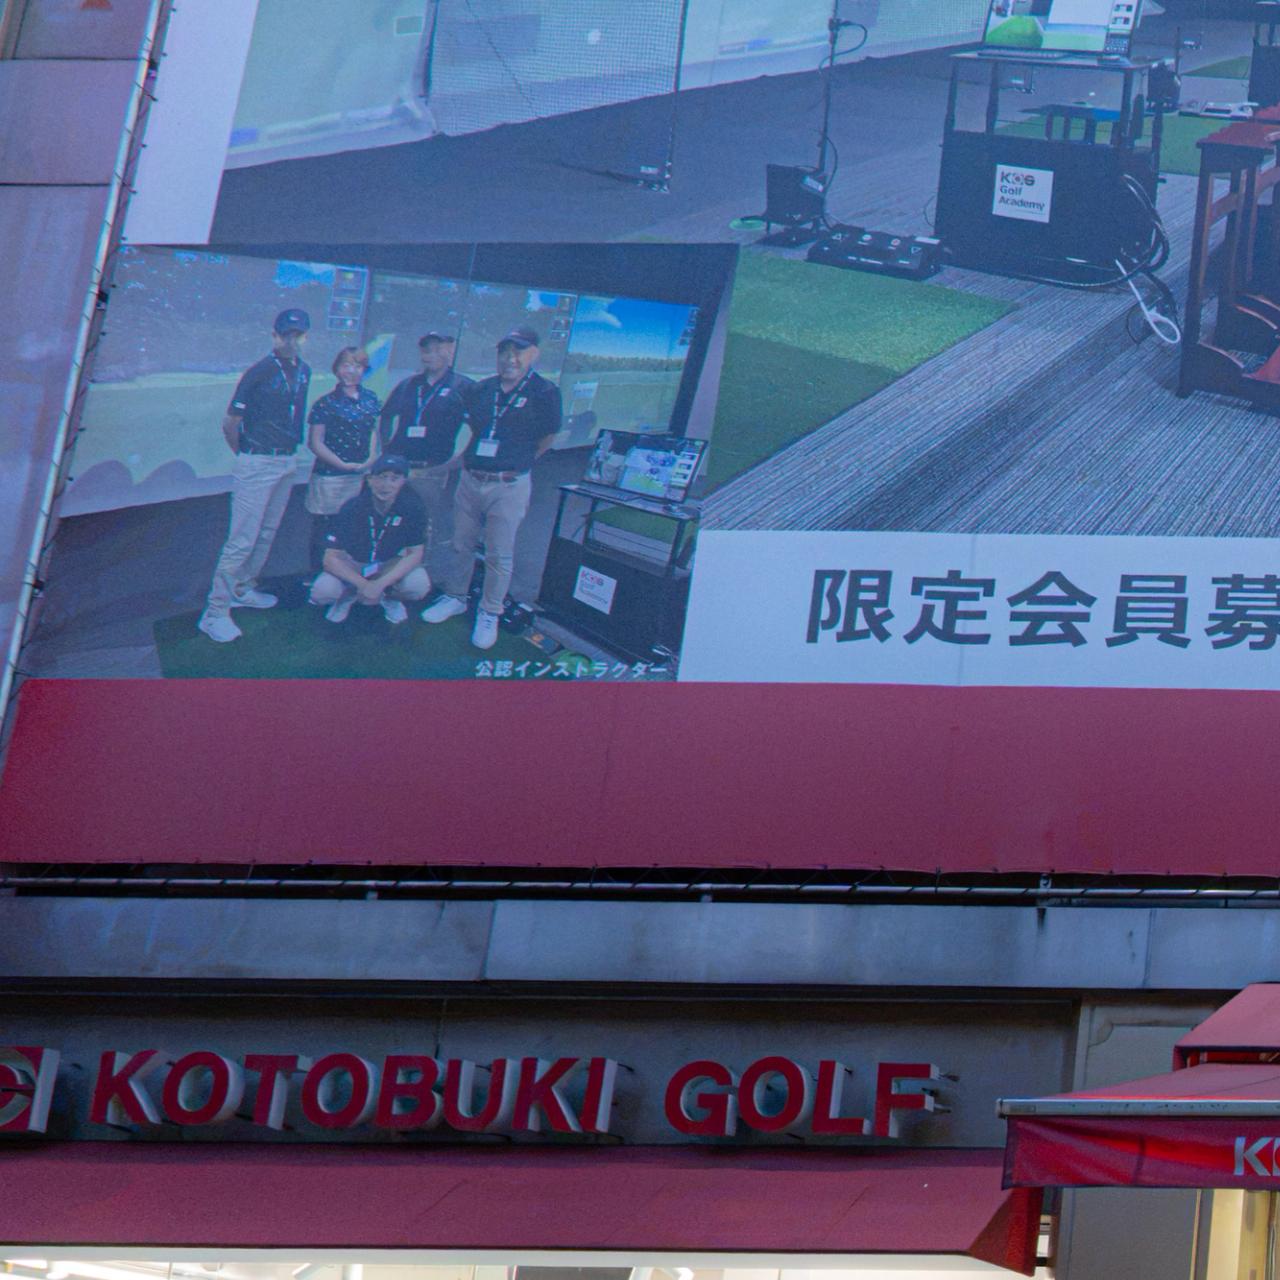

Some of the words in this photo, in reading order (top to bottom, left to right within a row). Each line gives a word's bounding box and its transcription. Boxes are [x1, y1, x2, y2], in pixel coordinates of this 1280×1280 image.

[1000, 185, 1023, 197] Golf
[998, 195, 1046, 212] Academy
[475, 660, 668, 678] 公認インストラクター
[92, 1049, 617, 1134] KOTOBUKI
[664, 1056, 946, 1138] GOLF
